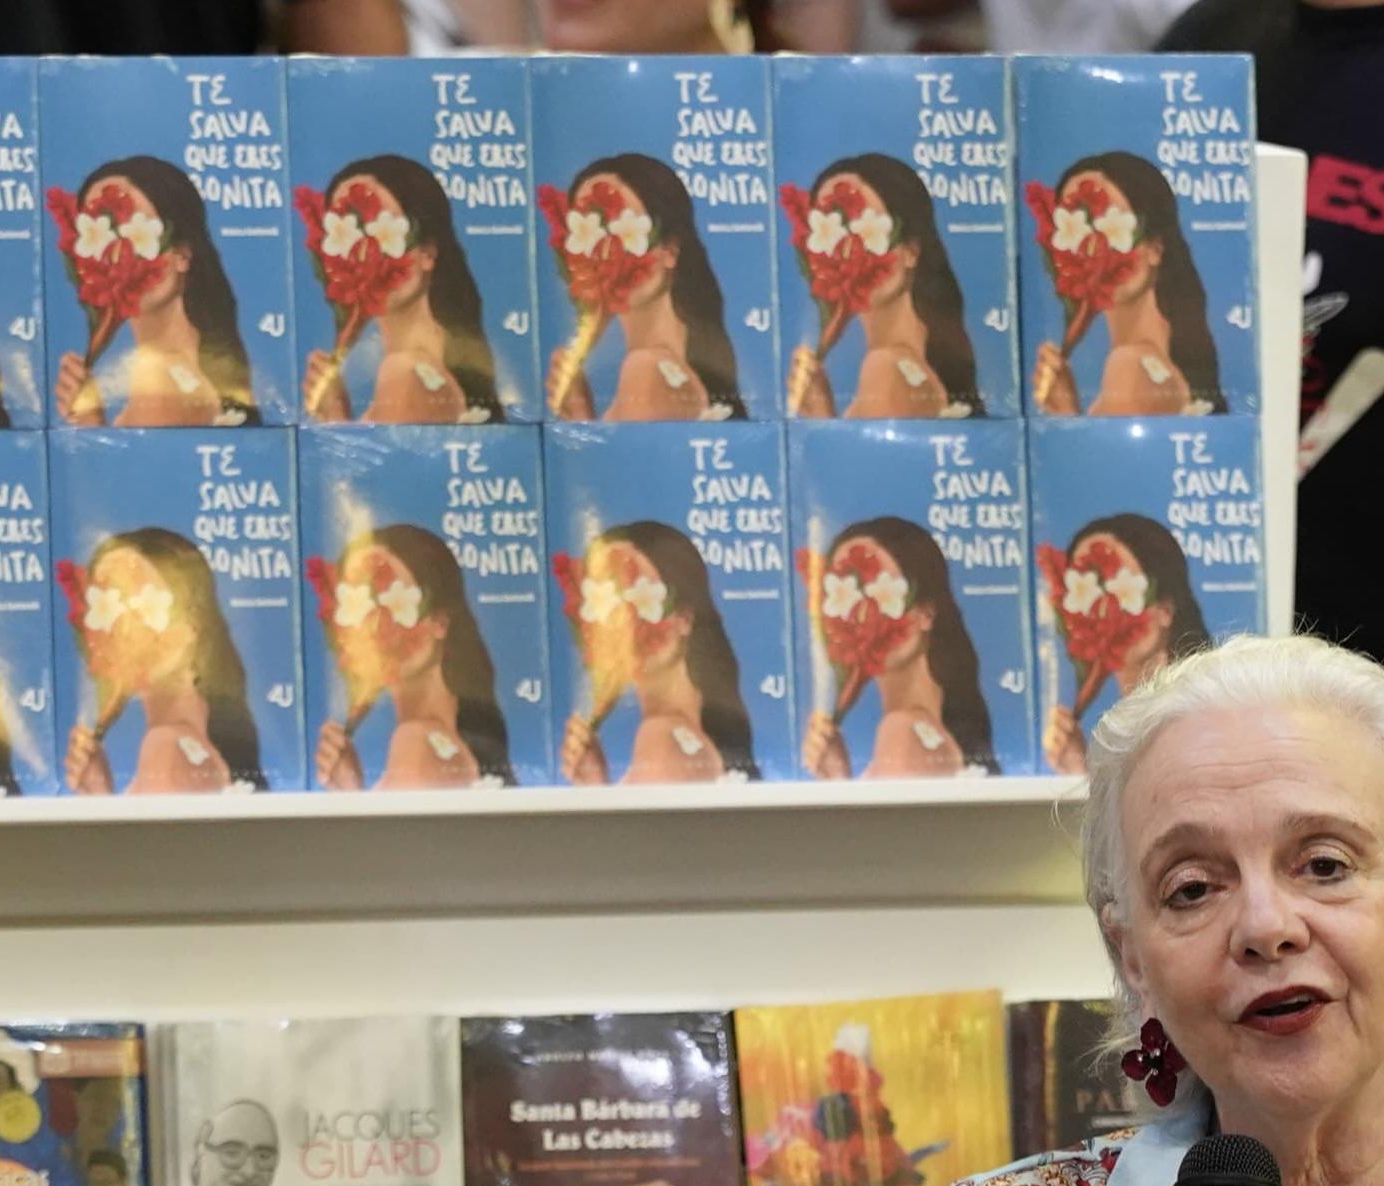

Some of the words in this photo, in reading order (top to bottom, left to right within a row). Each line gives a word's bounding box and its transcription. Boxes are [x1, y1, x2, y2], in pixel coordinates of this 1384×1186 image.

[186, 74, 232, 106] TE
[431, 73, 477, 105] TE
[674, 72, 718, 104] TE
[914, 72, 959, 104] TE
[1159, 70, 1203, 103] TE
[189, 110, 271, 141] SALVA
[435, 109, 515, 139] SALVA
[678, 108, 757, 138] SALVA
[918, 108, 997, 139] SALVA
[1162, 107, 1241, 136] SALVA
[184, 144, 229, 173] QUE
[234, 144, 282, 170] ERES
[429, 143, 475, 172] QUE
[479, 143, 527, 169] ERES
[672, 141, 716, 170] QUE
[721, 141, 768, 167] ERES
[913, 142, 957, 171] QUE
[962, 142, 1009, 168] ERES
[1157, 140, 1200, 167] QUE
[1206, 139, 1251, 166] ERES
[196, 444, 241, 477] TE
[442, 440, 488, 474] TE
[689, 438, 733, 471] TE
[928, 434, 973, 467] TE
[1169, 432, 1212, 464] TE
[199, 481, 280, 512] SALVA
[447, 477, 527, 508] SALVA
[692, 474, 772, 505] SALVA
[933, 470, 1012, 501] SALVA
[1173, 467, 1250, 498] SALVA
[194, 515, 239, 544] QUE
[244, 514, 292, 541] ERES
[442, 511, 486, 540] QUE
[491, 510, 538, 537] ERES
[687, 508, 731, 537] QUE
[736, 507, 783, 534] ERES
[928, 504, 972, 533] QUE
[976, 503, 1024, 529] ERES
[1167, 501, 1211, 530] QUE
[1216, 503, 1262, 528] ERES
[510, 1100, 577, 1123] Santa
[580, 1097, 670, 1121] Bárbara
[672, 1098, 702, 1119] de
[300, 1109, 442, 1144] JACQUES
[541, 1127, 582, 1151] Las
[584, 1126, 676, 1151] Cabezas
[299, 1137, 443, 1181] GILARD
